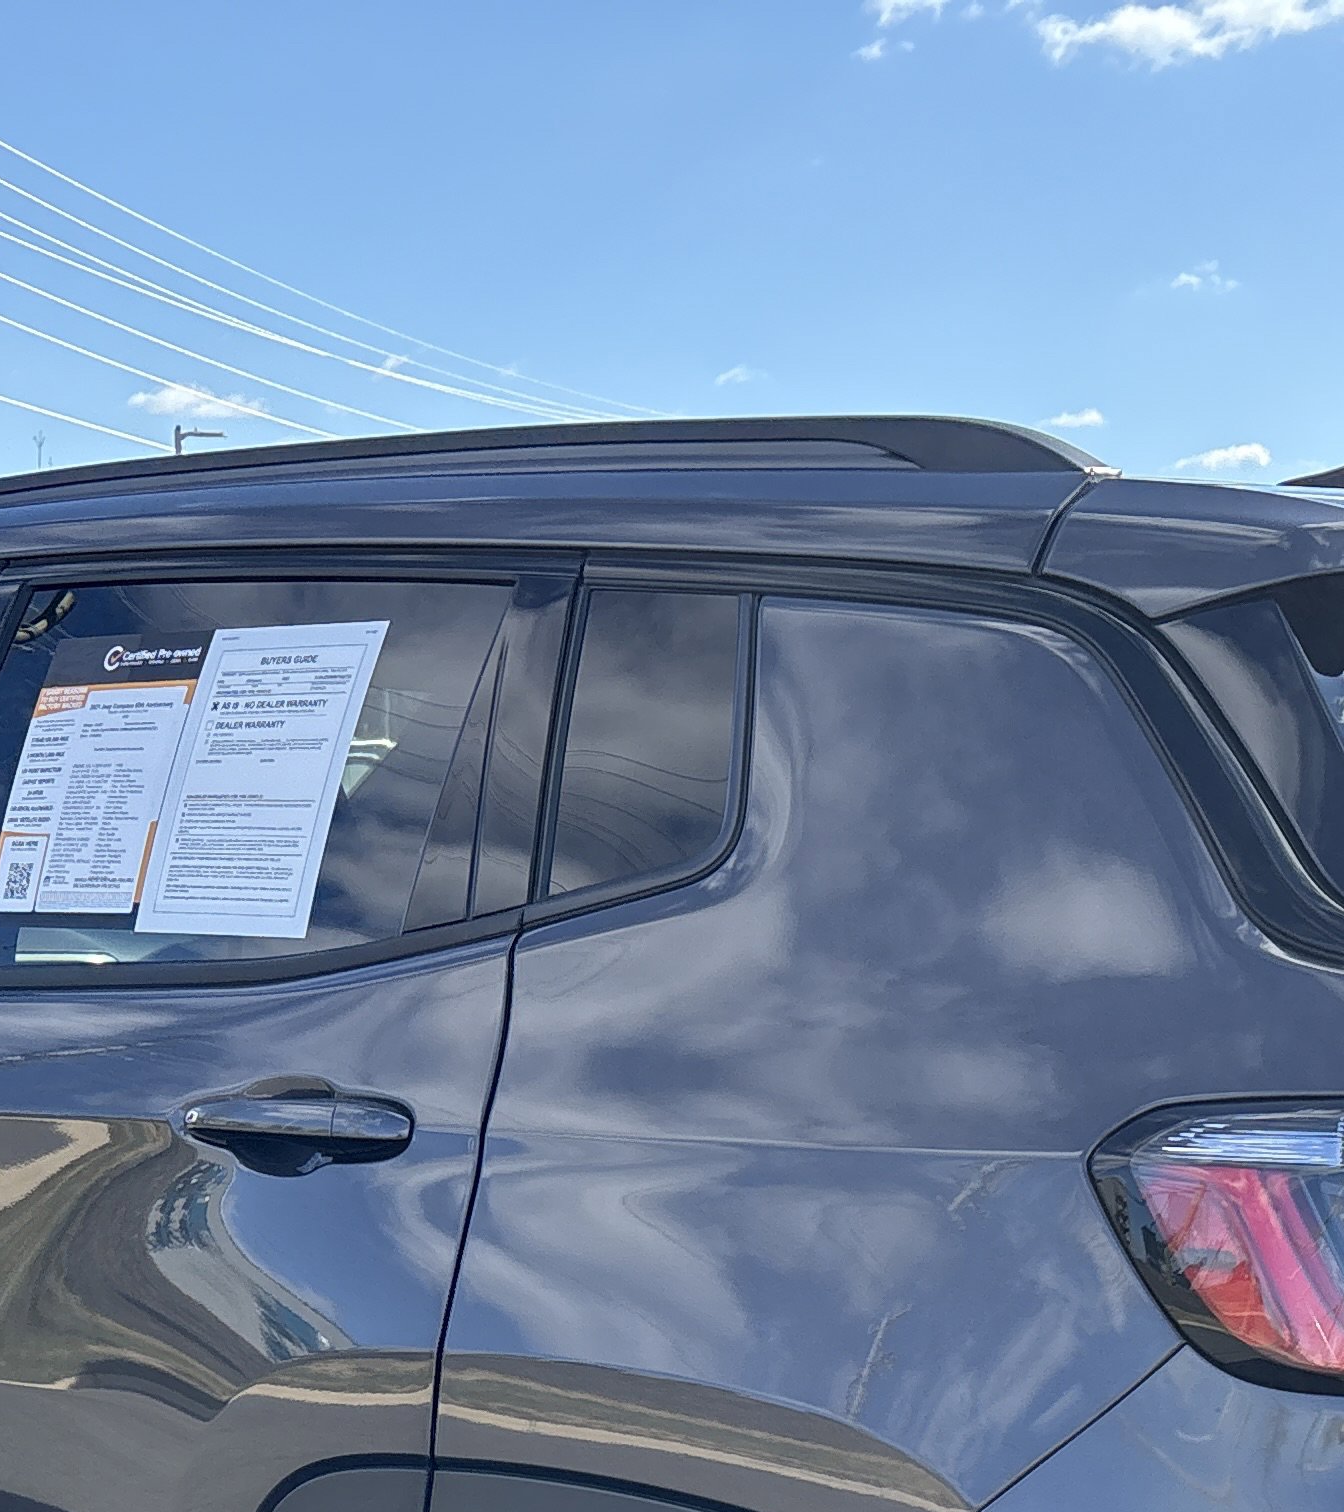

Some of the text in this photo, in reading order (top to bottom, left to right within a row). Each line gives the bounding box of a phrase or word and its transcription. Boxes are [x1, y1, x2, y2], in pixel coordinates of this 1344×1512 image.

[260, 655, 319, 665] BUYERS GUIDE
[256, 700, 285, 709] DEALER
[286, 699, 328, 708] WARRANTY
[215, 720, 285, 730] DEALER WARRANTY
